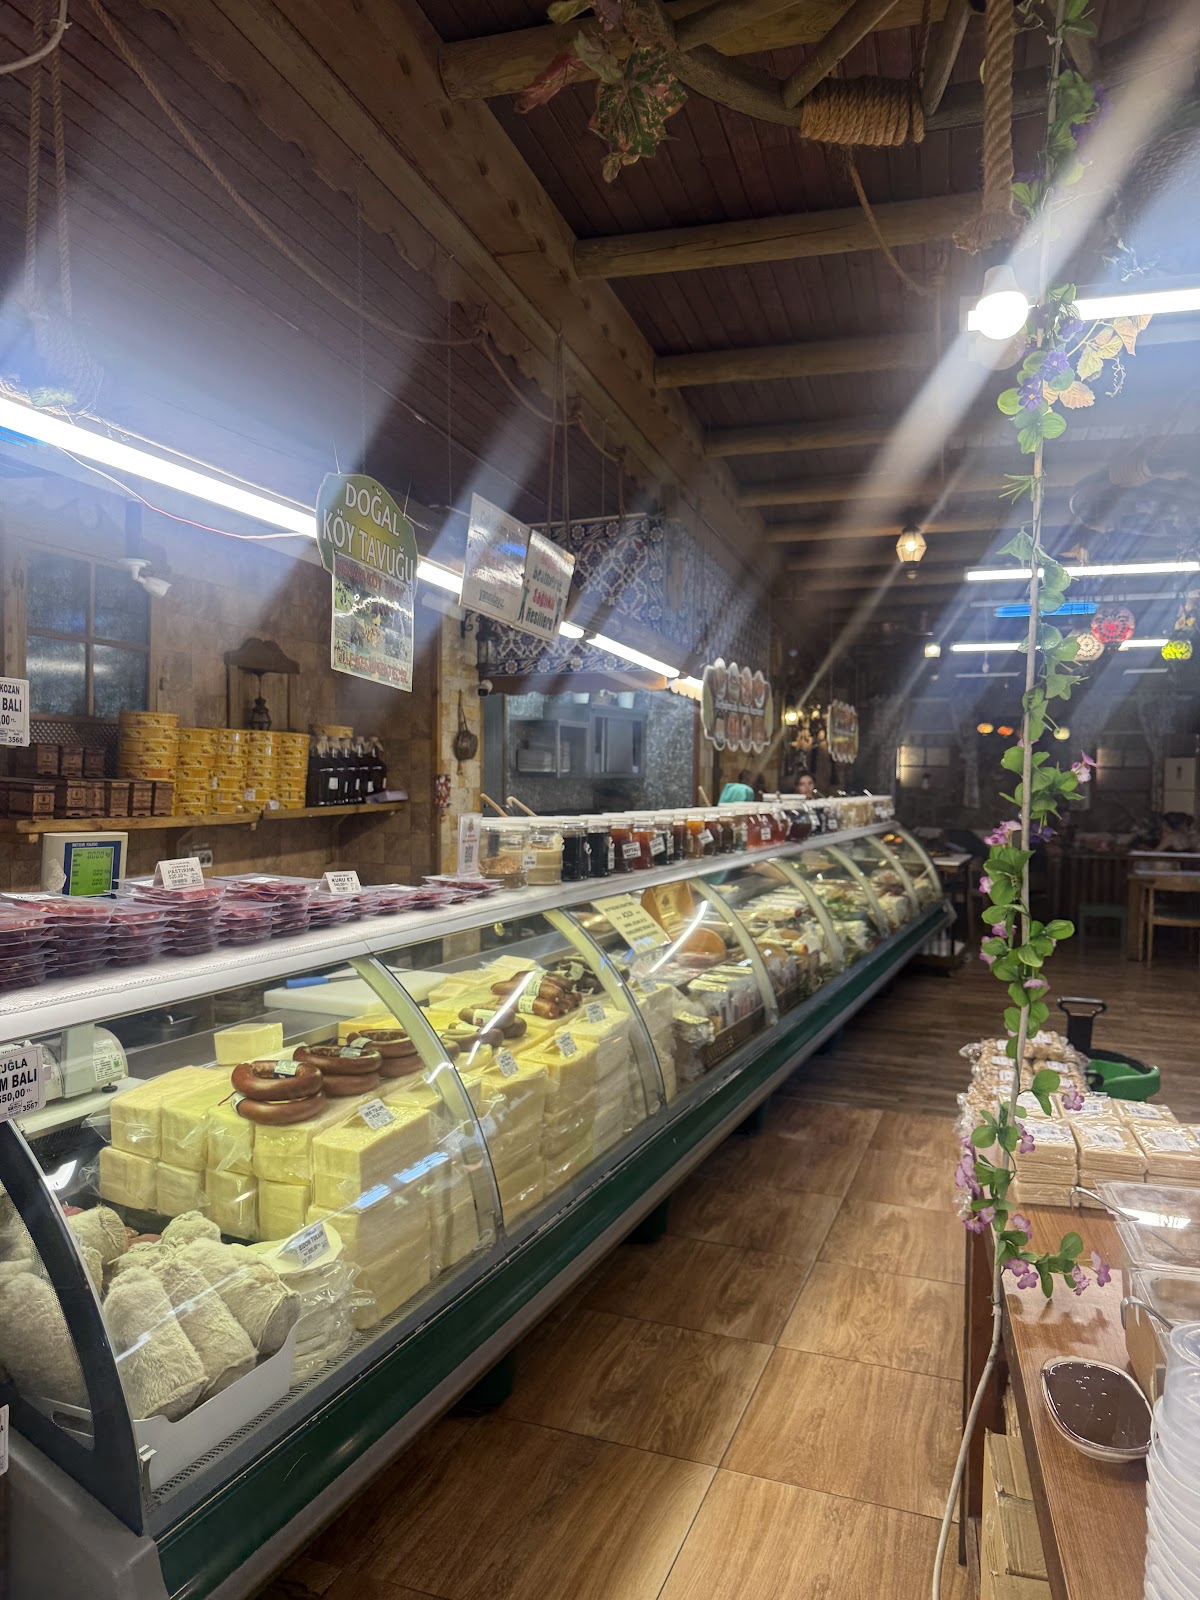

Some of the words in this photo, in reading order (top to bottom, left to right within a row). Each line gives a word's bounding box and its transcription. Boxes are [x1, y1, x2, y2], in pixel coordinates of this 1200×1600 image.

[345, 482, 400, 537] DOĞAL
[323, 508, 355, 553] KÖY
[358, 529, 414, 586] TAVUĞU
[0, 684, 20, 695] KOZAN
[2, 697, 22, 713] BALI
[0, 714, 10, 726] 00
[12, 1068, 37, 1088] BALI
[22, 1101, 38, 1112] 3567
